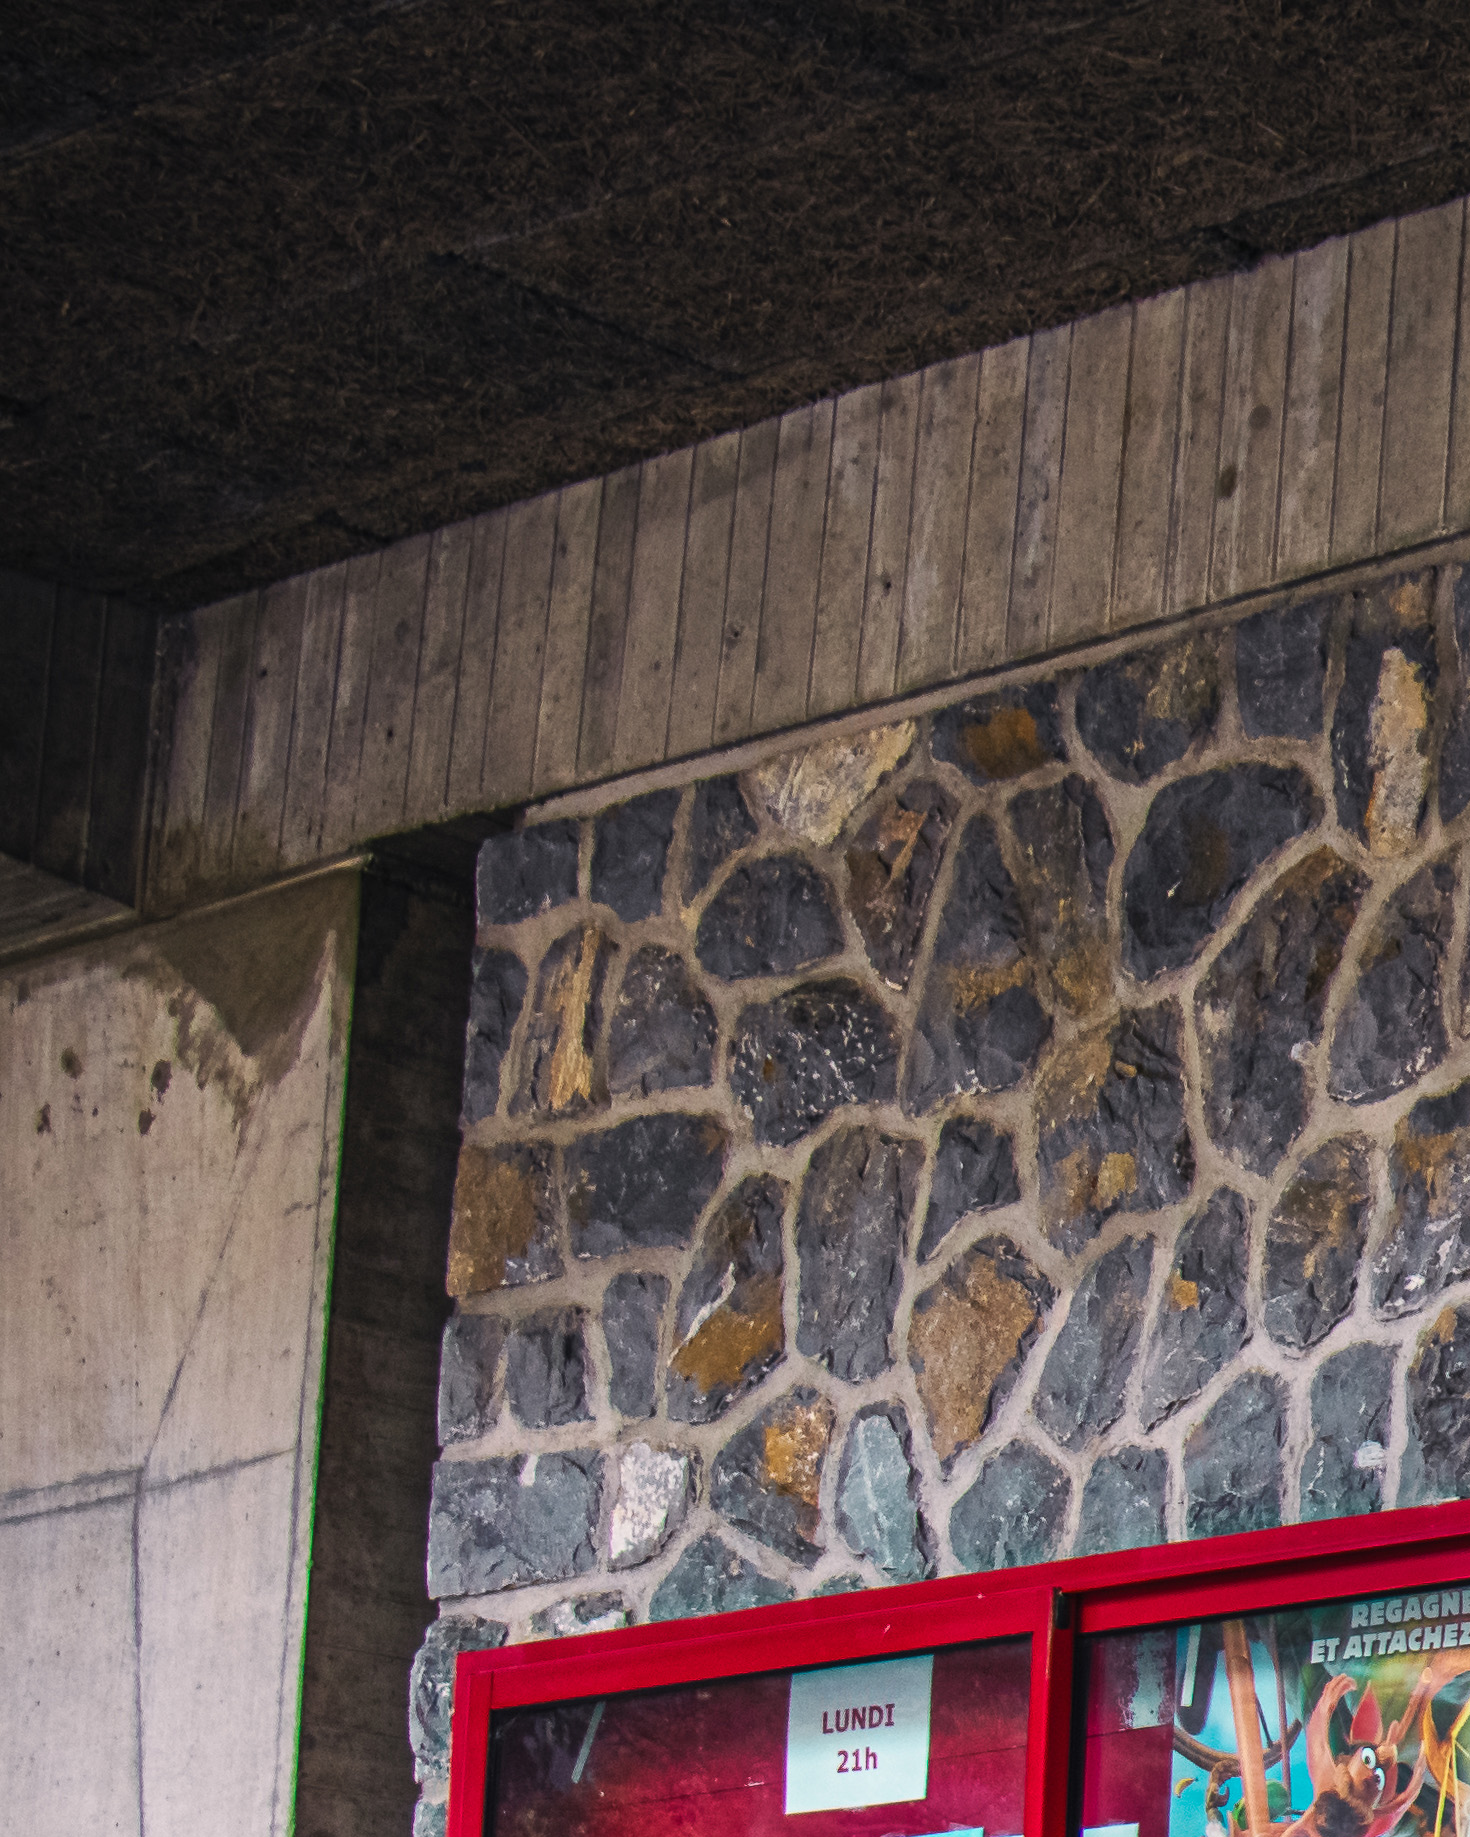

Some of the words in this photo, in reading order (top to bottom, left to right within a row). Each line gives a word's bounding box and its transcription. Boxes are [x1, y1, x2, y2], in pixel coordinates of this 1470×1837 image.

[1311, 1637, 1342, 1665] ET
[822, 1703, 895, 1735] LUNDI
[836, 1746, 878, 1774] 21h
